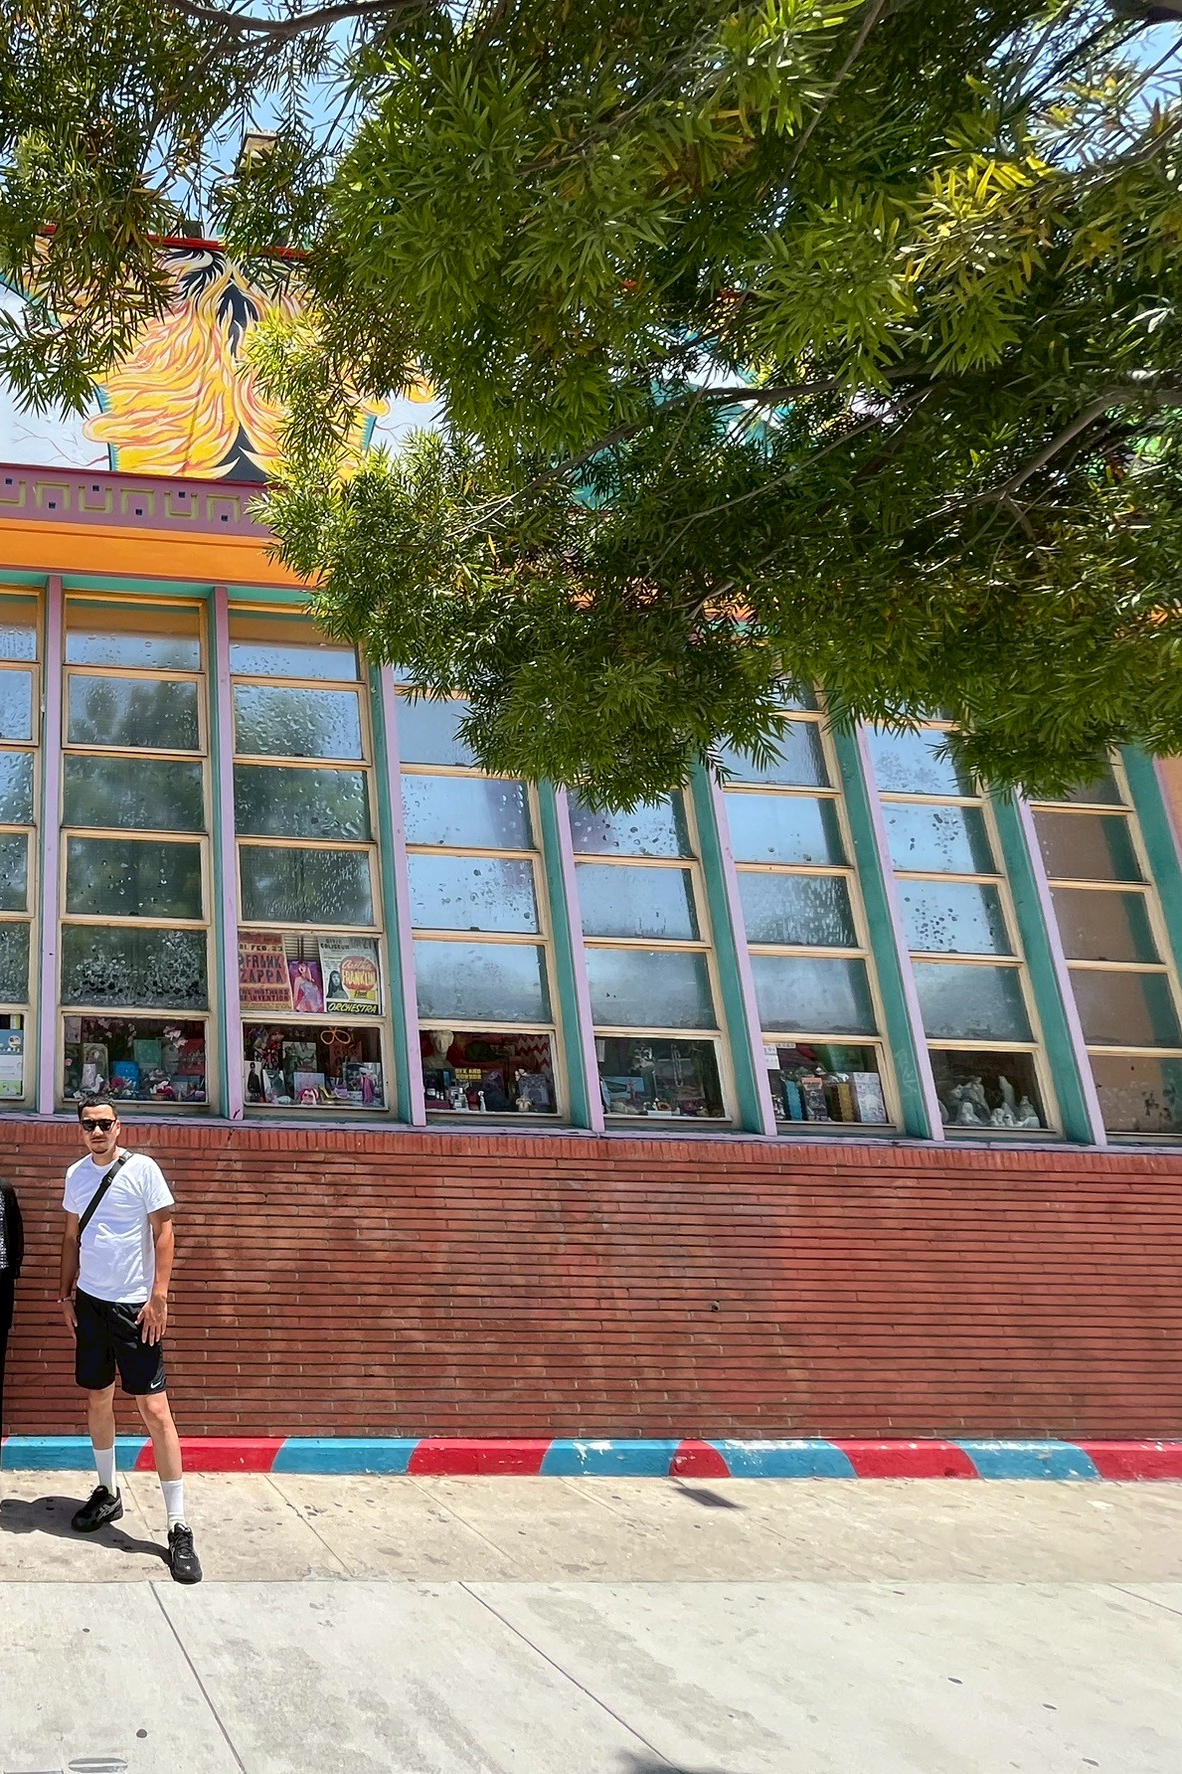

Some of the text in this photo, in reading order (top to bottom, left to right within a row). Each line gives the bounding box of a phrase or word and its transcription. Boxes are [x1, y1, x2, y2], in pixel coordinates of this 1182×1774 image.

[245, 954, 282, 969] FRANK
[342, 958, 373, 970] Aretha
[239, 969, 284, 984] ZAPPA
[342, 970, 375, 985] FRANKLIN
[328, 1002, 377, 1013] ORCHESTRA
